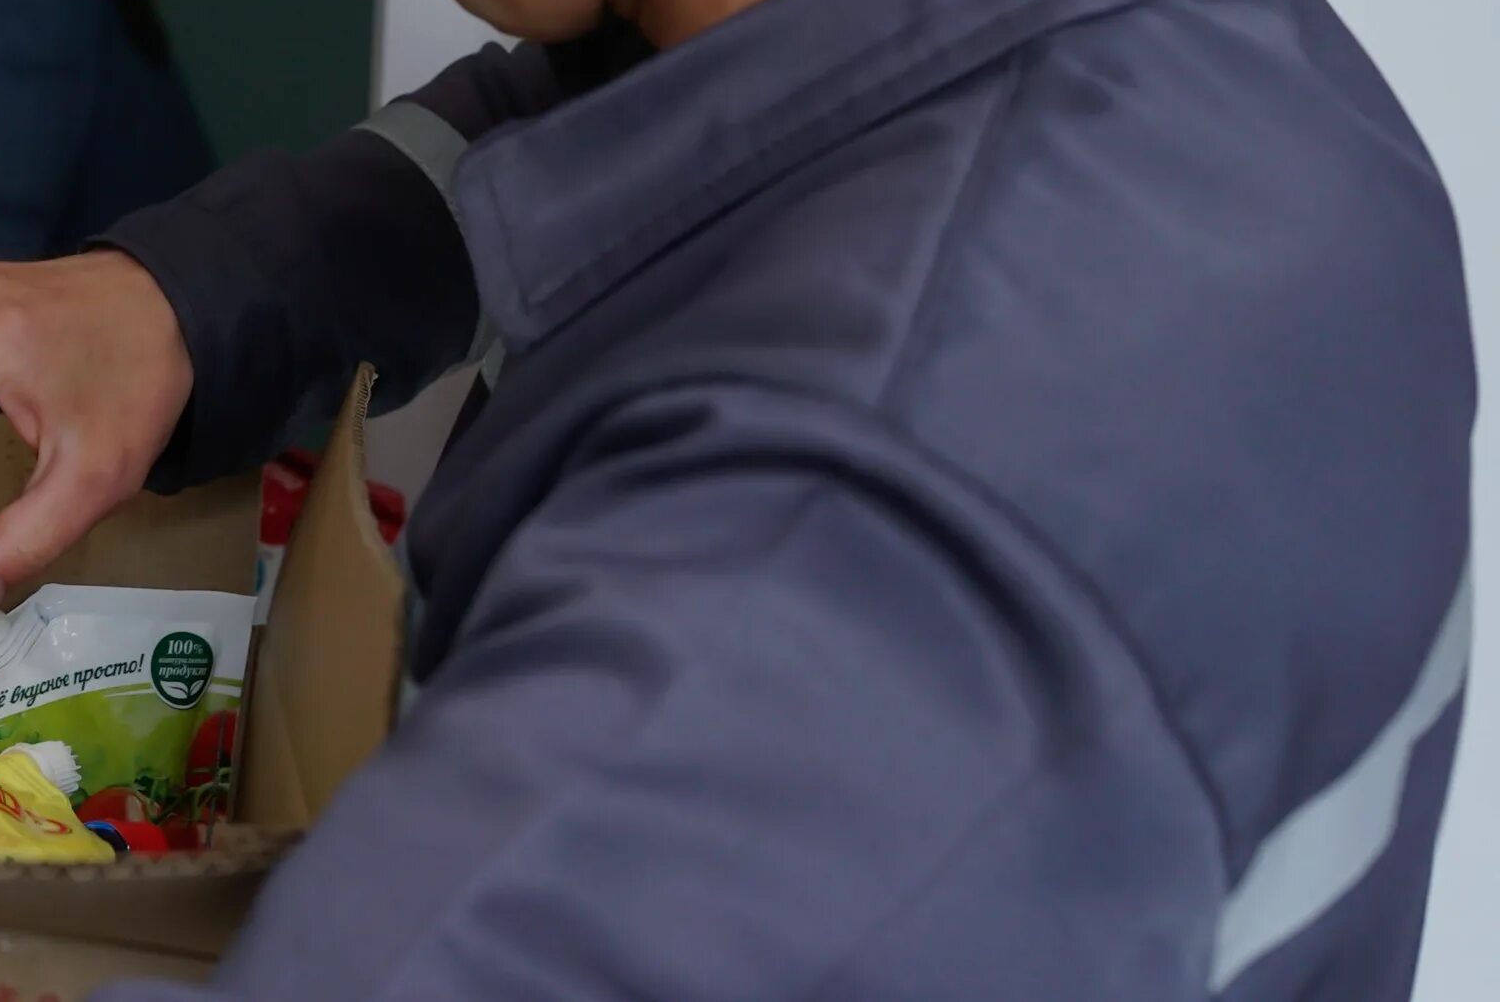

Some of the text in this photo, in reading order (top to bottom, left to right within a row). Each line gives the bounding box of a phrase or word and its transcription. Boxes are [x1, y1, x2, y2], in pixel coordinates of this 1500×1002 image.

[167, 638, 204, 655] 100%
[158, 663, 208, 679] продукт
[10, 674, 70, 707] вкусное
[73, 653, 145, 691] просто!
